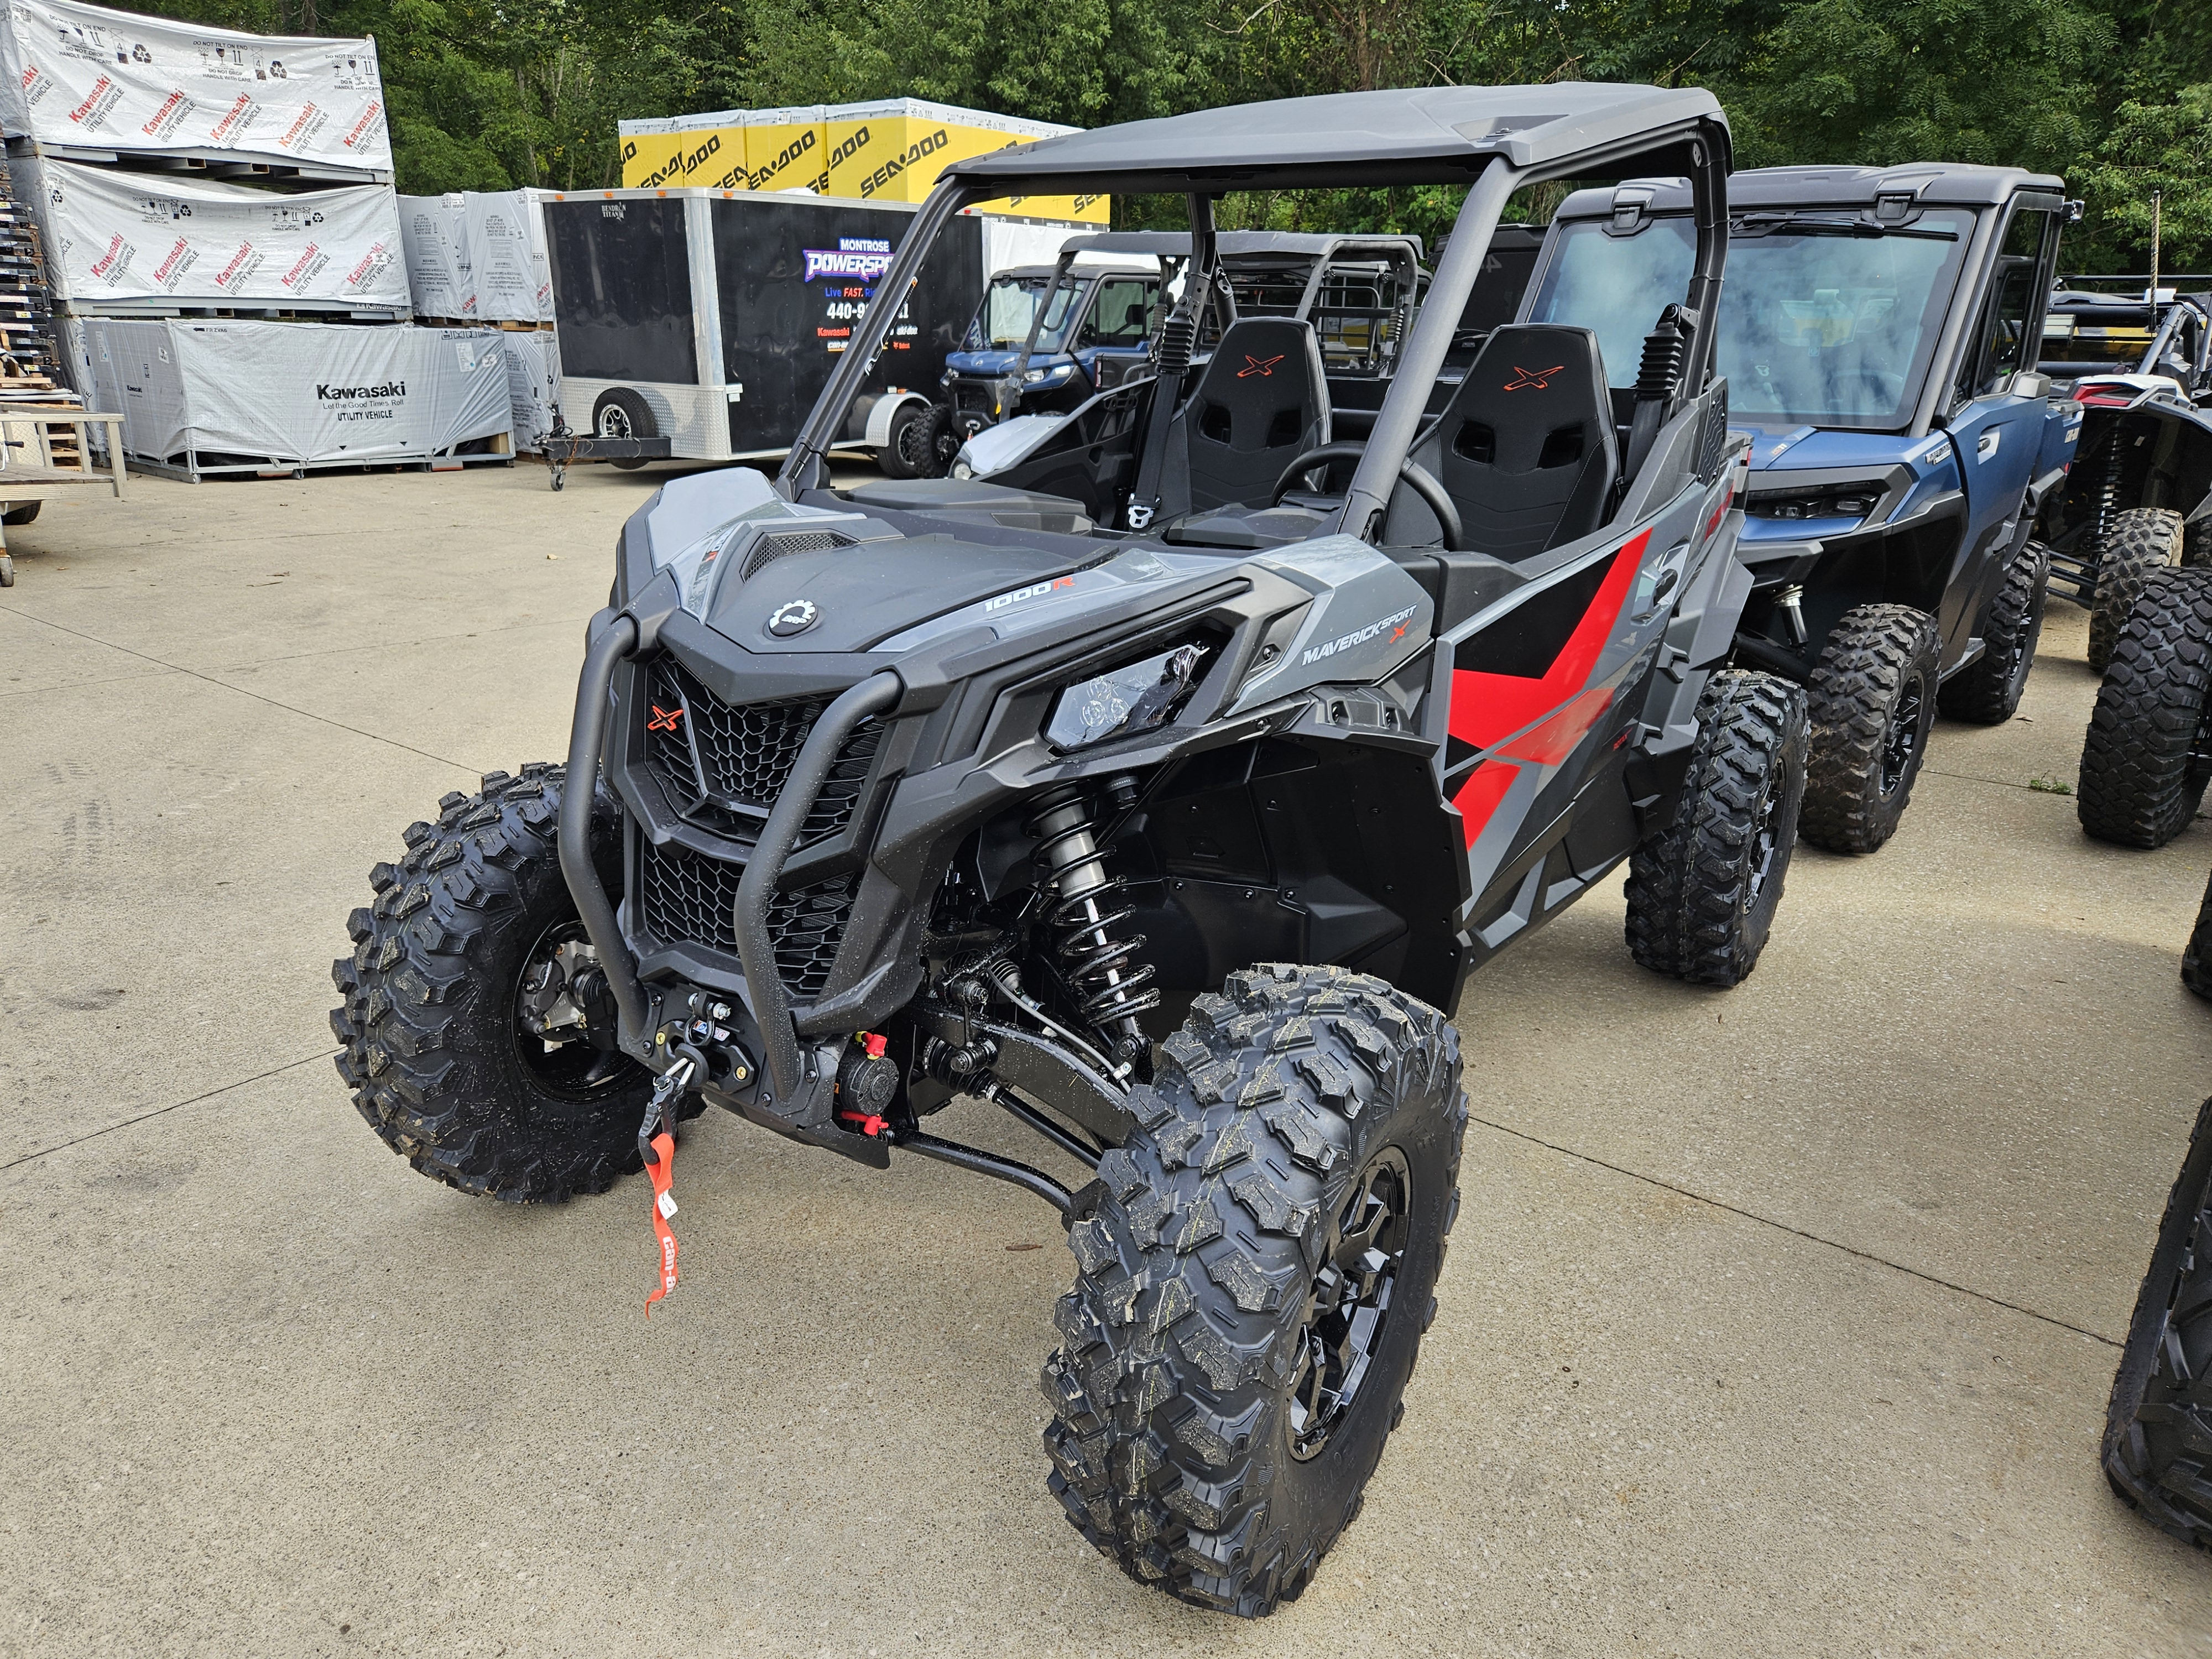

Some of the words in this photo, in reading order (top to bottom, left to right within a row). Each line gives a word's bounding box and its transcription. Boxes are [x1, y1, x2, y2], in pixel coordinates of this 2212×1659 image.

[59, 51, 81, 59] HANDLE
[28, 80, 53, 105] VEHICLE
[68, 73, 111, 123] Kawasaki
[87, 110, 107, 132] UTILITY
[104, 88, 124, 111] VEHICLE
[142, 88, 185, 135] Kawasaki
[161, 124, 176, 142] UTILITY
[174, 101, 196, 125] VEHICLE
[210, 92, 250, 140] Kawasaki
[227, 127, 244, 149] UTILITY
[241, 105, 262, 128] VEHICLE
[278, 100, 317, 147] Kawasaki
[296, 134, 312, 154] UTILITY
[309, 112, 329, 135] VEHICLE
[343, 100, 380, 147] Kawasaki
[358, 134, 374, 155] UTILITY
[153, 236, 188, 282] Kawasaki
[215, 240, 253, 286] Kawasaki
[281, 242, 319, 286] Kawasaki
[841, 239, 889, 252] MONTROSE
[108, 264, 127, 287] UTILITY
[167, 272, 182, 293] UTILITY
[180, 250, 199, 272] VEHICLE
[230, 274, 248, 295] UTILITY
[245, 254, 265, 275] VEHICLE
[295, 275, 312, 296] UTILITY
[310, 254, 330, 276] VEHICLE
[361, 273, 377, 294] UTILITY
[825, 288, 841, 297] Live
[844, 288, 863, 297] FAST.
[817, 327, 850, 337] Kawasaki
[316, 381, 406, 400] Kawasaki
[338, 412, 363, 421] UTILITY
[365, 410, 393, 420] VEHICLE
[985, 577, 1076, 612] 1000R
[781, 615, 807, 624] BRP
[1302, 621, 1382, 666] MAVERICK
[1380, 605, 1417, 630] SPORT
